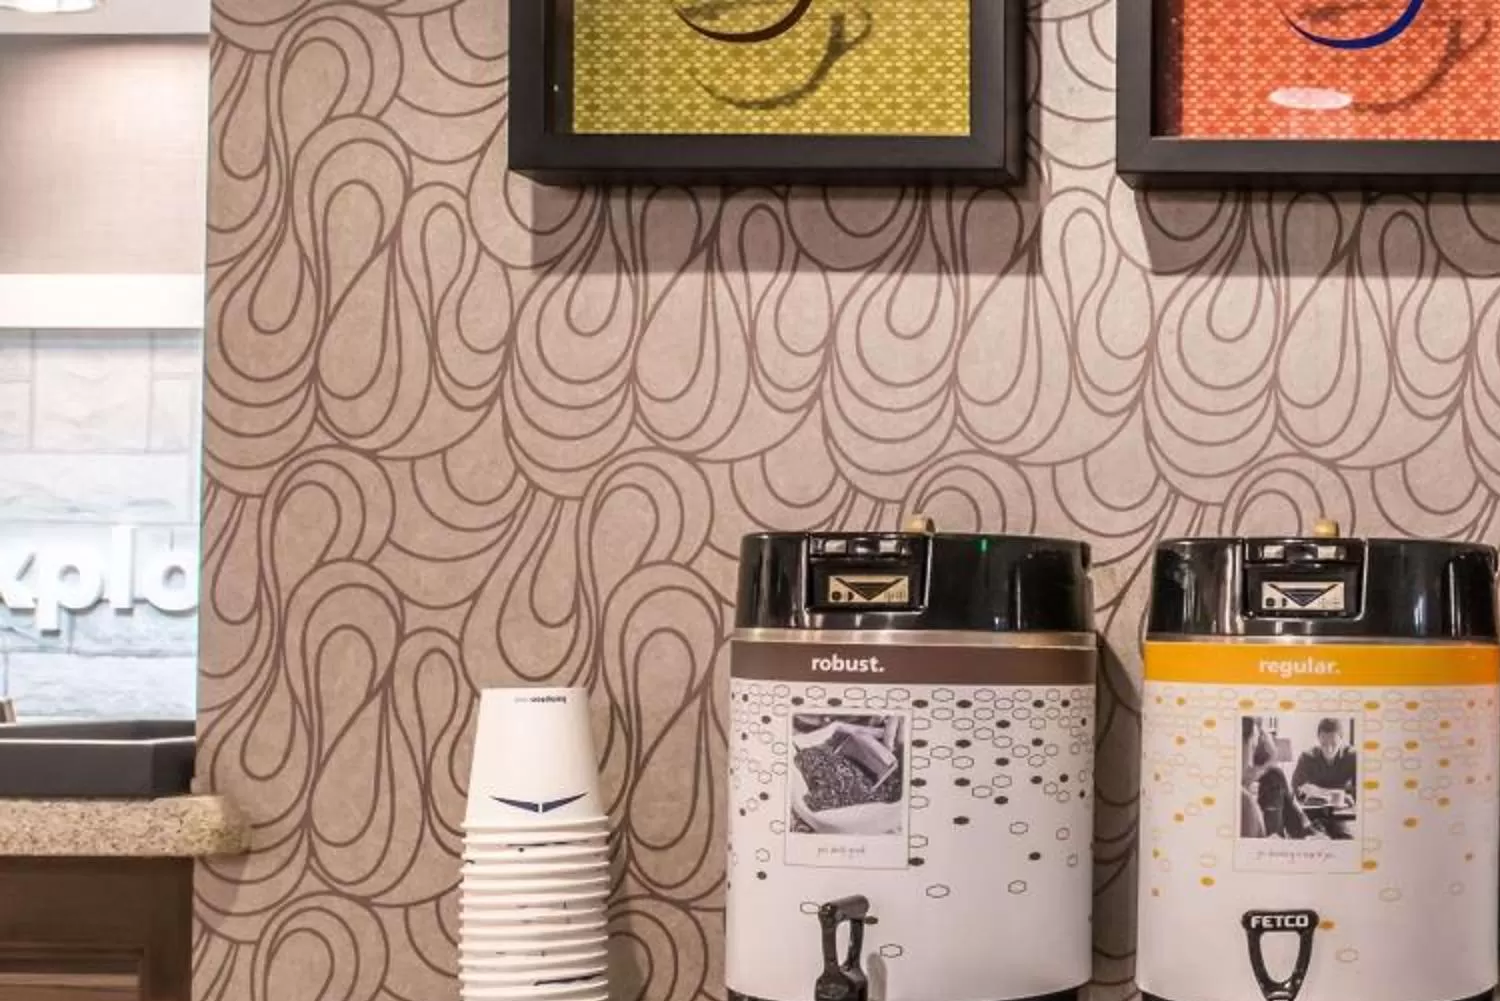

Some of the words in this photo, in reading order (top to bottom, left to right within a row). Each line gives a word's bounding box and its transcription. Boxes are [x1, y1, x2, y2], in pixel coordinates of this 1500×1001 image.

[810, 652, 886, 673] robust.
[1258, 655, 1342, 680] regular.
[1250, 914, 1310, 929] FETCO
